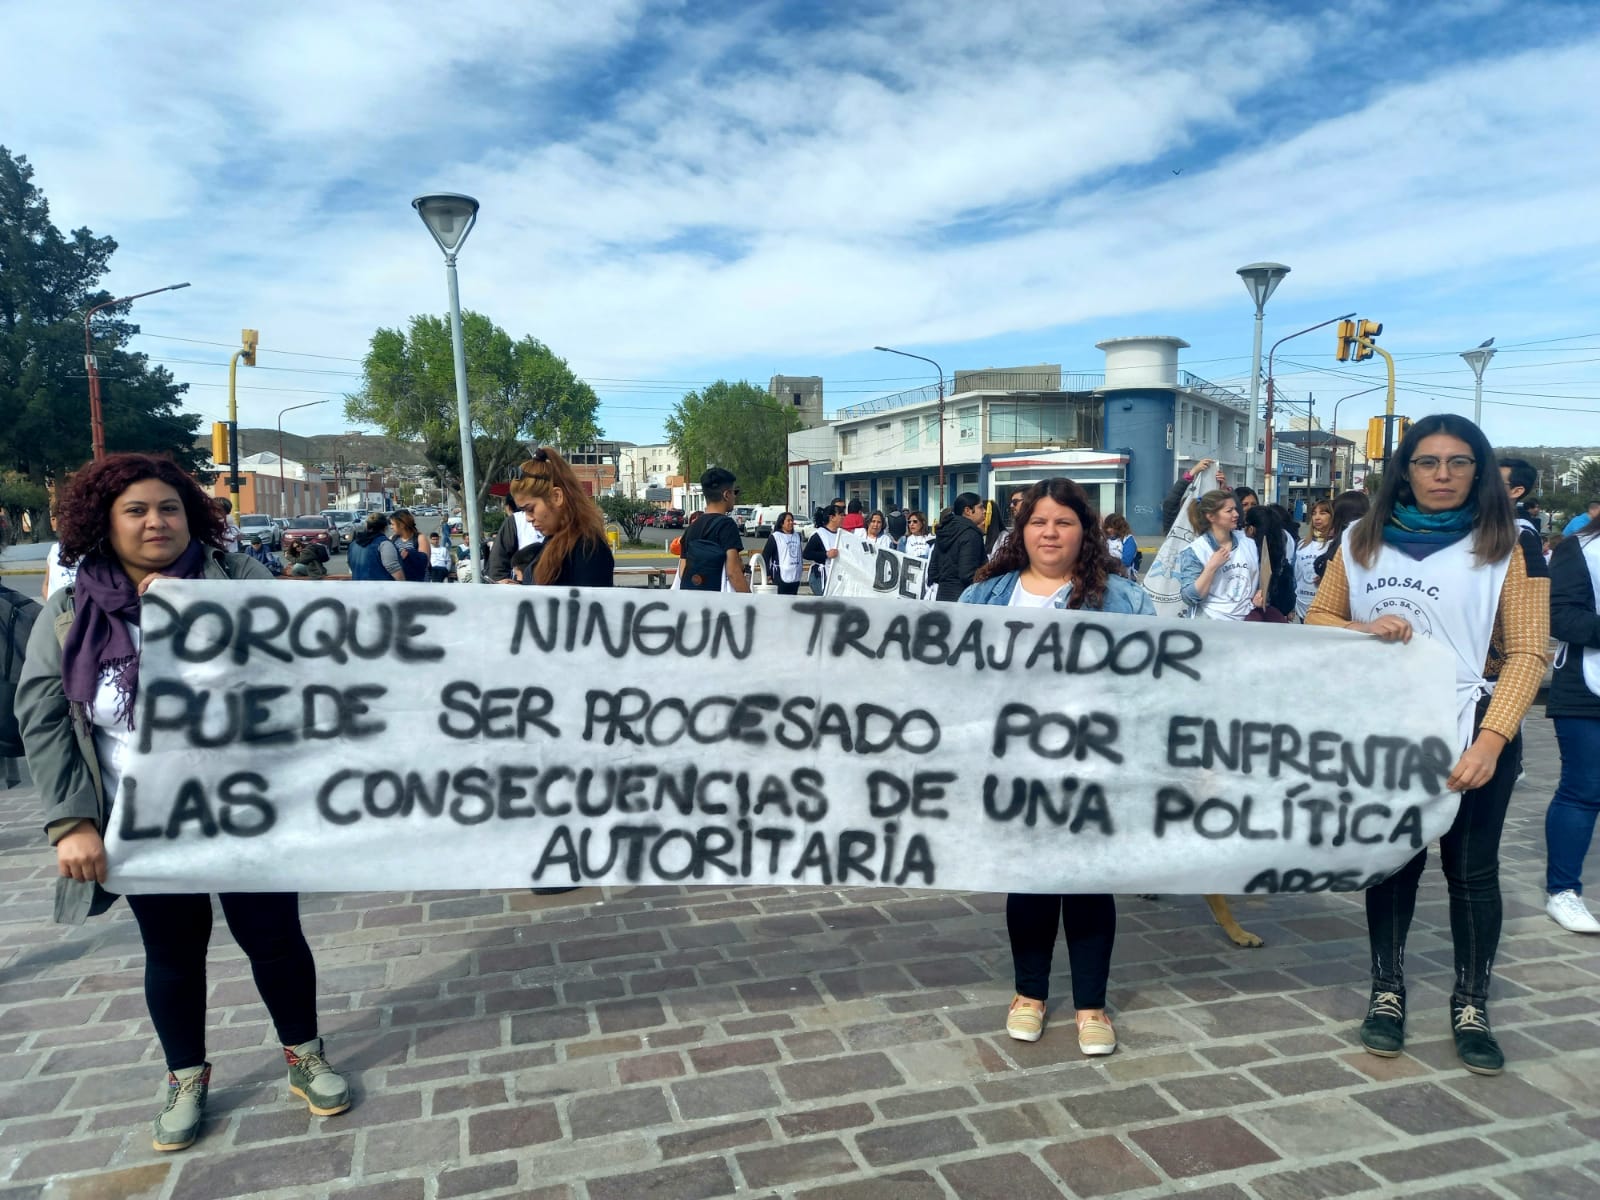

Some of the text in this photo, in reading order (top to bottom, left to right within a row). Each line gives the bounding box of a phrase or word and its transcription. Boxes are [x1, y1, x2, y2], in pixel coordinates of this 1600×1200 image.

[141, 593, 456, 665] PORQUE
[791, 601, 1203, 681] TRABAJADOR
[138, 678, 1454, 797] PUEDE SER PROCESADO POR ENFRENTAR
[119, 764, 1424, 850] LAS CONSECUENCIAS DE UNA POLÍTICA
